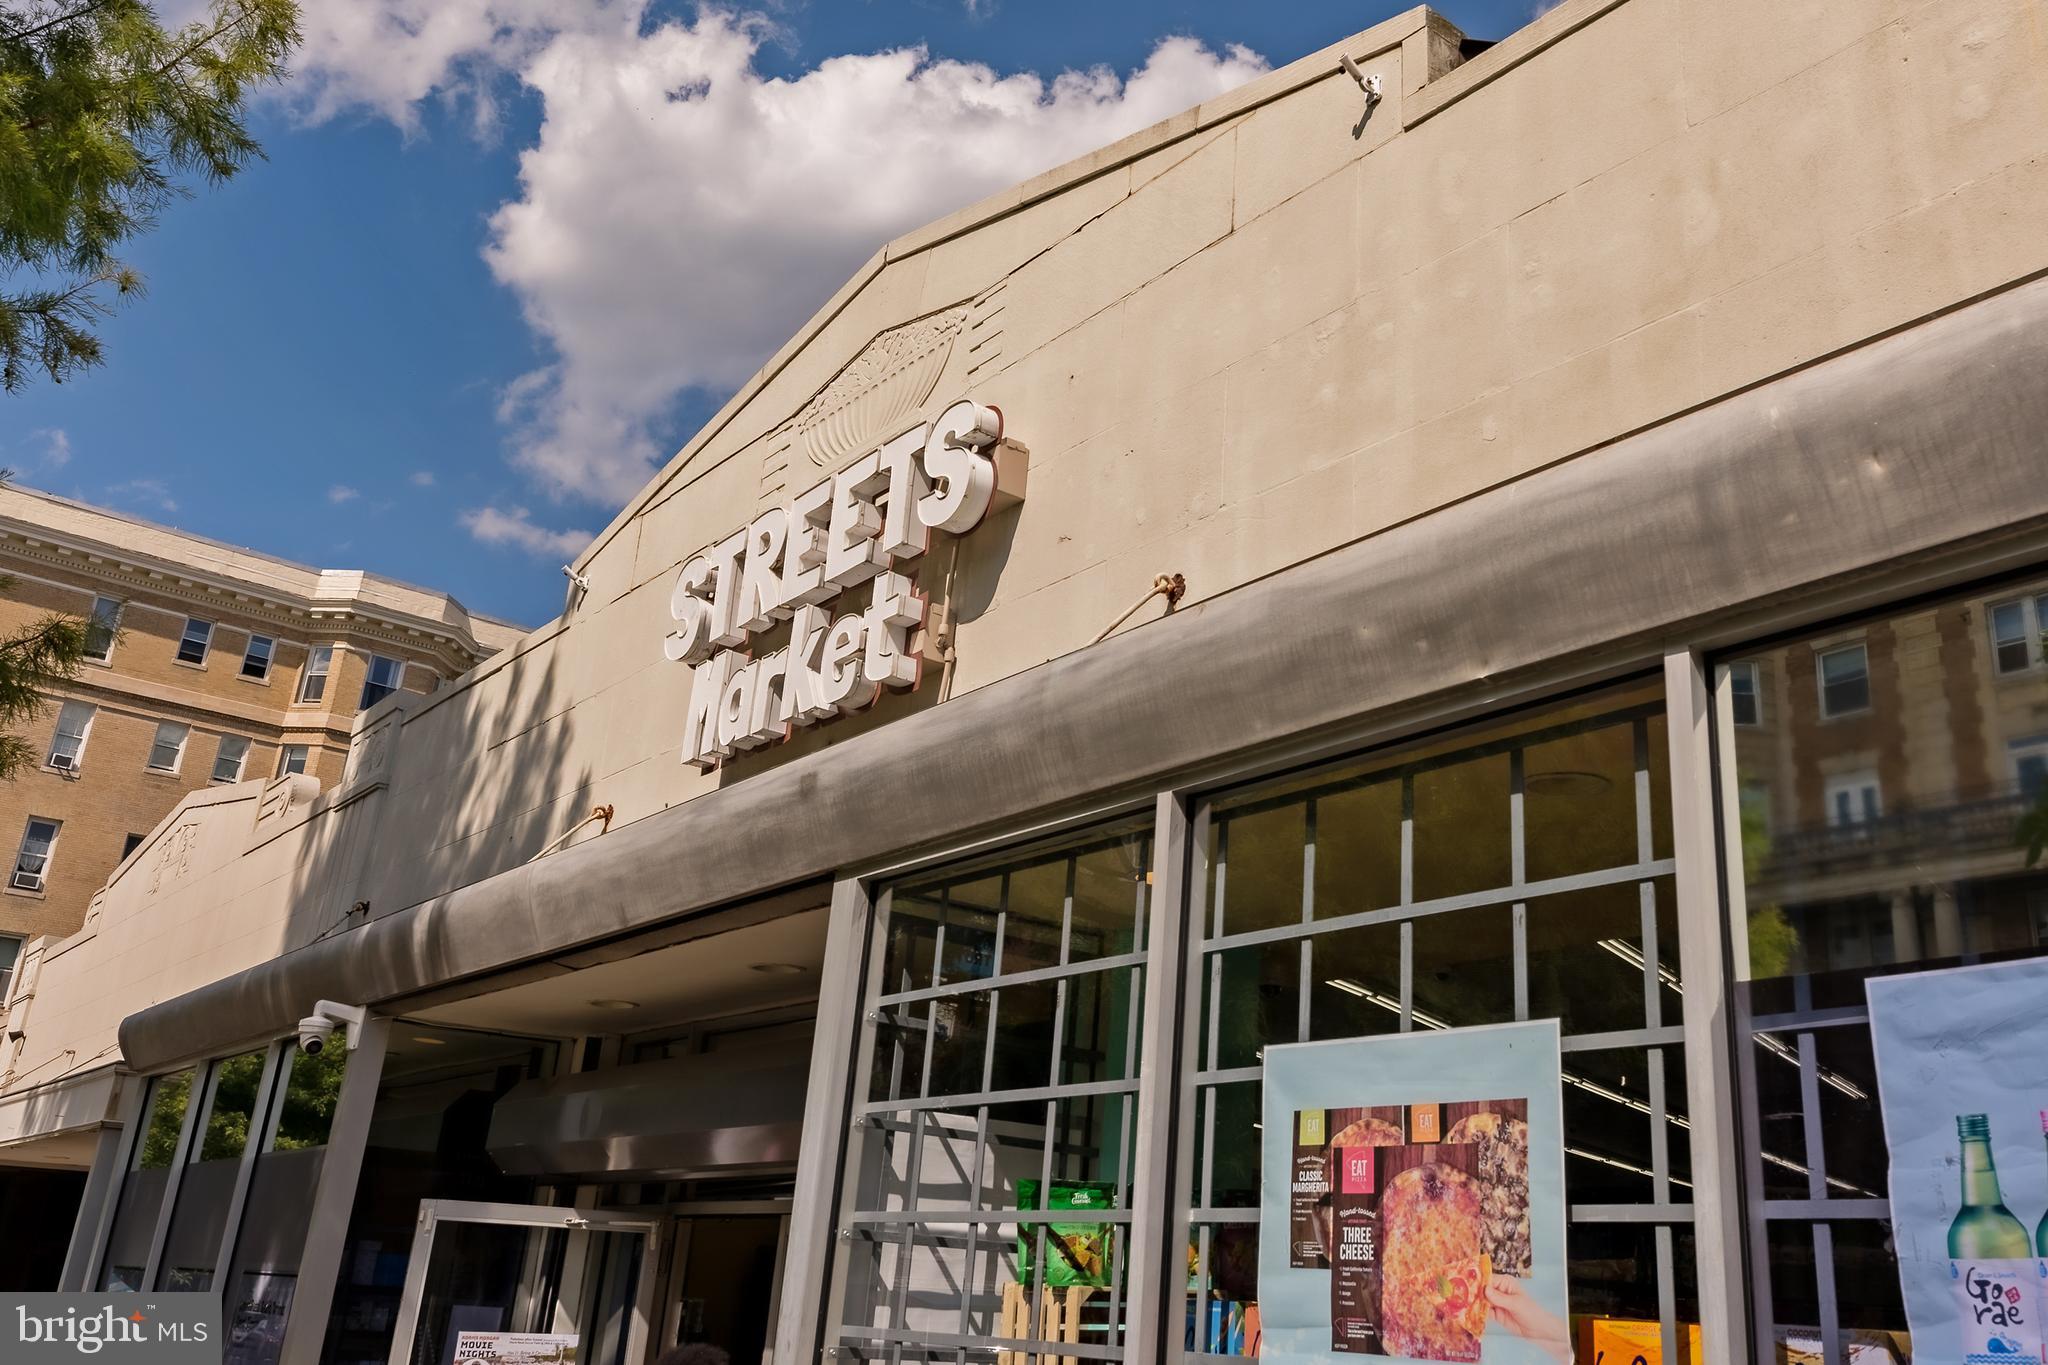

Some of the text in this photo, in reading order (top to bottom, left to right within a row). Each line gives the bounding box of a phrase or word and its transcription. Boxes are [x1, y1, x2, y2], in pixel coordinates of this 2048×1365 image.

[664, 399, 1003, 665] STREETS
[681, 570, 925, 767] Market
[1307, 1119, 1320, 1132] EAT
[1418, 1113, 1433, 1128] EAT
[1299, 1171, 1323, 1181] CLASSIC
[1351, 1159, 1367, 1177] EAT
[1292, 1182, 1329, 1193] MARGHERITA
[1342, 1226, 1372, 1243] THREE
[1339, 1243, 1374, 1260] CHEESE
[1966, 1266, 2003, 1304] Go
[1973, 1301, 2024, 1327] rae
[460, 1341, 494, 1349] MOVIE
[459, 1350, 497, 1358] NIGHTS
